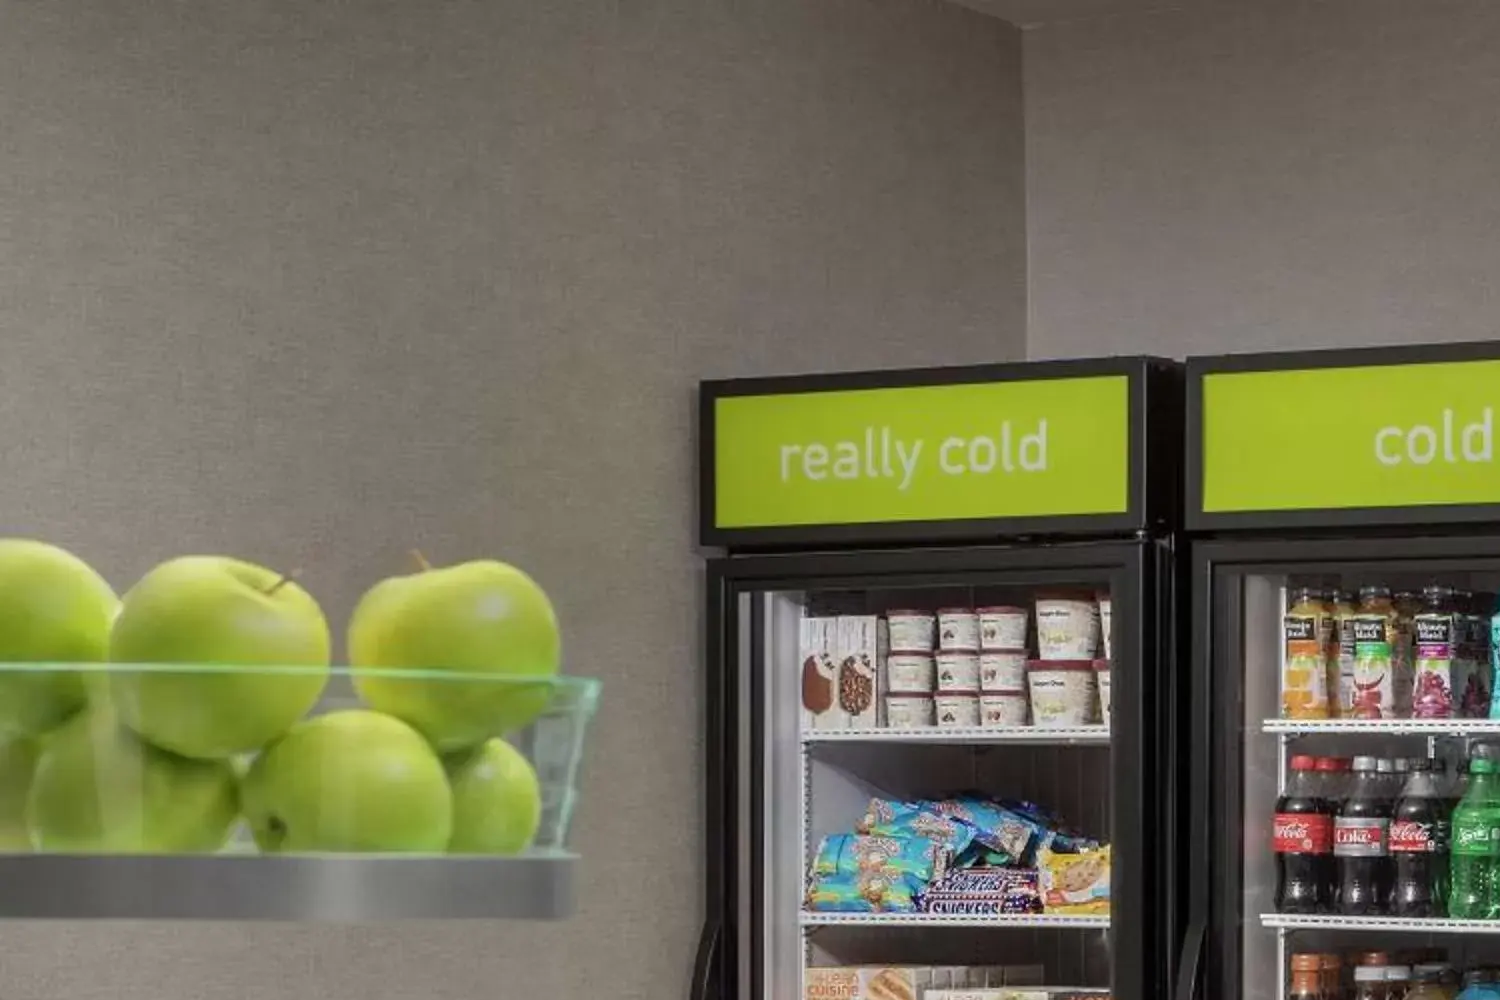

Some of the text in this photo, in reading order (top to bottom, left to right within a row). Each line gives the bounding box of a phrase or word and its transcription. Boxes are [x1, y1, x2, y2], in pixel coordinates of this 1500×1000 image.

[778, 420, 1048, 491] really cold
[1374, 407, 1494, 466] cold
[807, 984, 860, 997] cuisine
